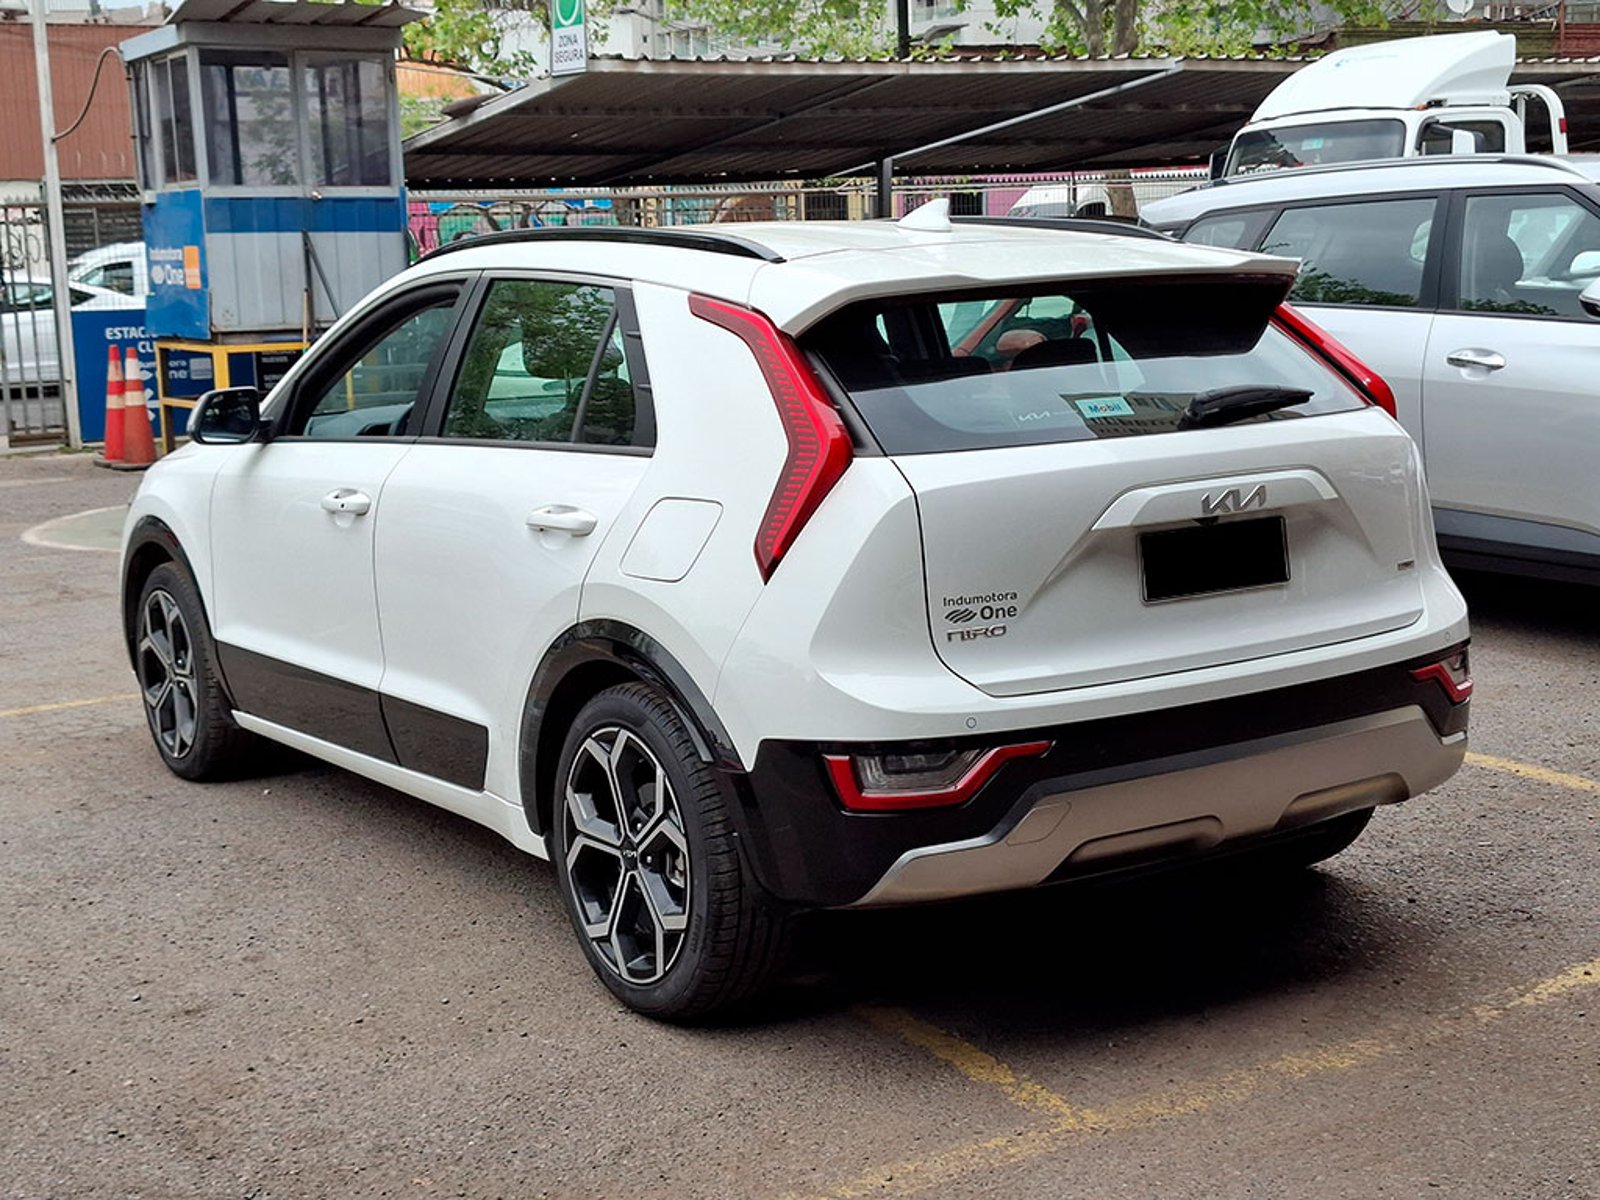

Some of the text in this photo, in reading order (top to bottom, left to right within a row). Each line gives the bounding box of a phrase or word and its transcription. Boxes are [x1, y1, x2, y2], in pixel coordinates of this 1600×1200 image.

[559, 34, 578, 48] ZONA
[554, 48, 584, 63] SEGURA
[165, 264, 184, 285] One
[105, 326, 159, 340] ESTAC
[1088, 403, 1122, 414] Mobil
[1201, 484, 1267, 515] KIA
[943, 591, 1018, 607] Indumotora
[980, 605, 1018, 620] One
